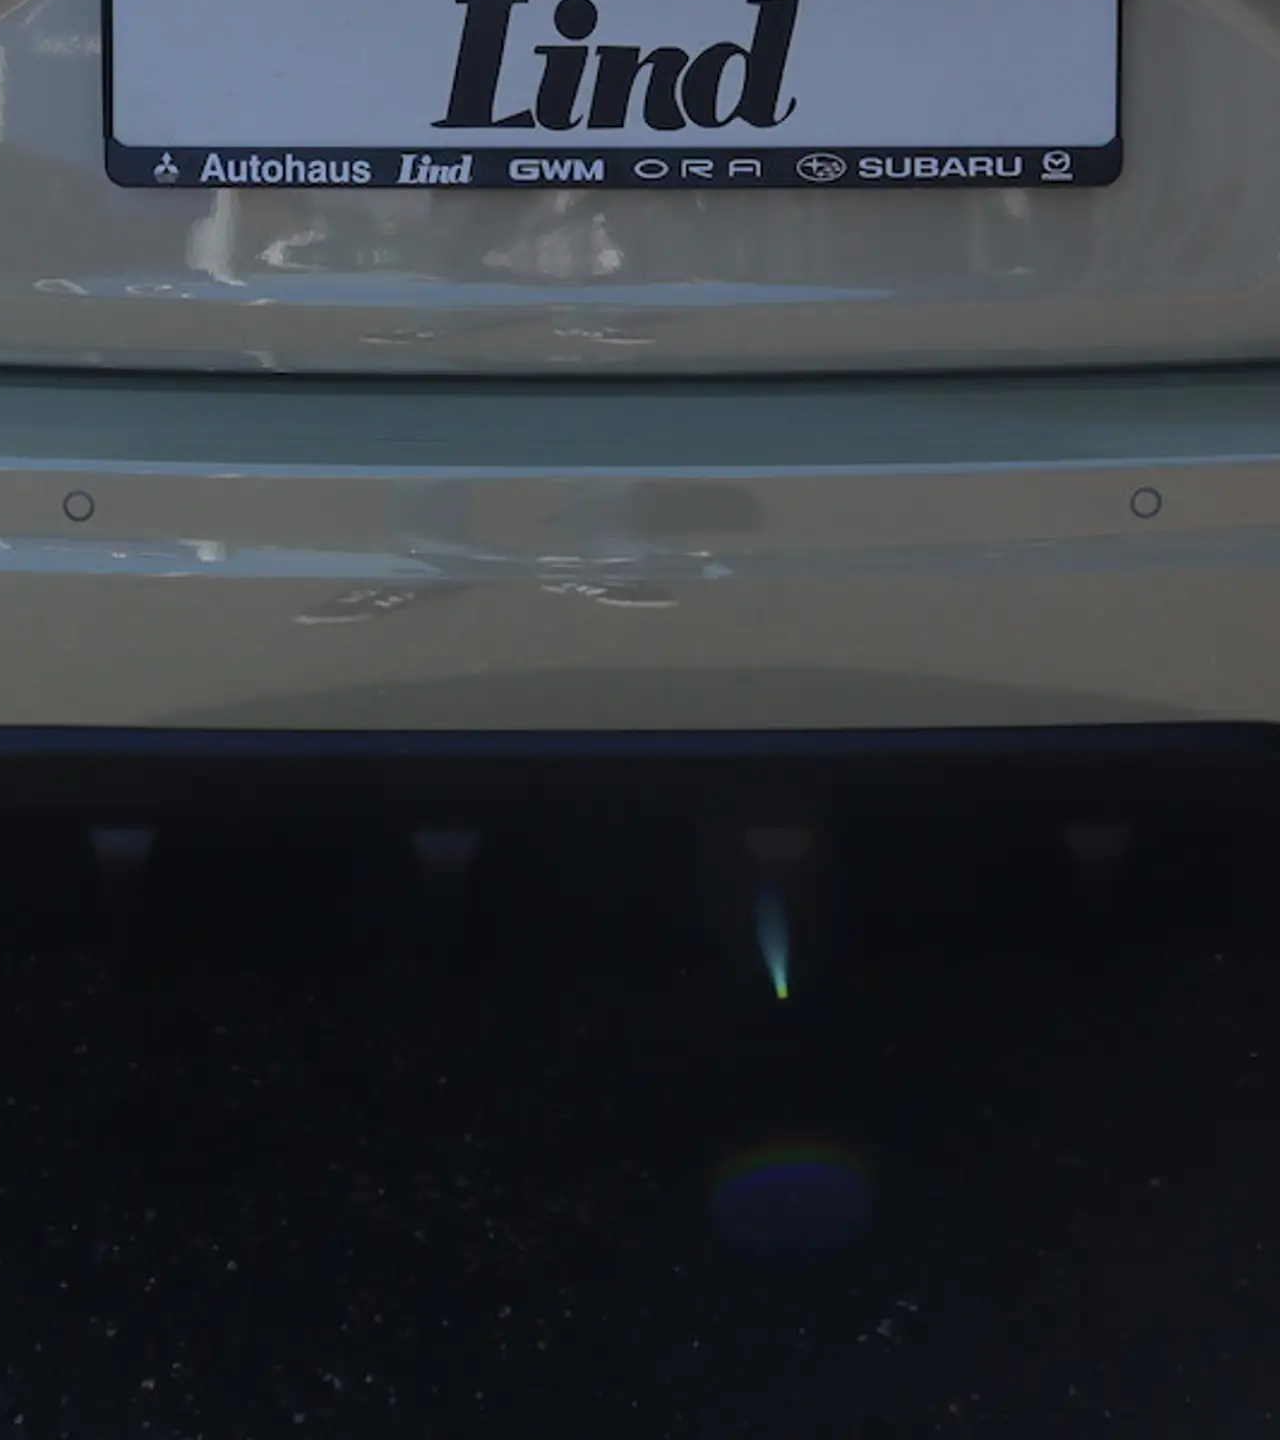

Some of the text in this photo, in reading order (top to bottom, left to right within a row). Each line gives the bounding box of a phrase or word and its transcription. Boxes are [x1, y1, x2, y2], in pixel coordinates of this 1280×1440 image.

[200, 153, 372, 184] Autohaus
[396, 154, 473, 184] Lind
[509, 158, 604, 181] GWM
[858, 156, 1022, 179] SUBARU
